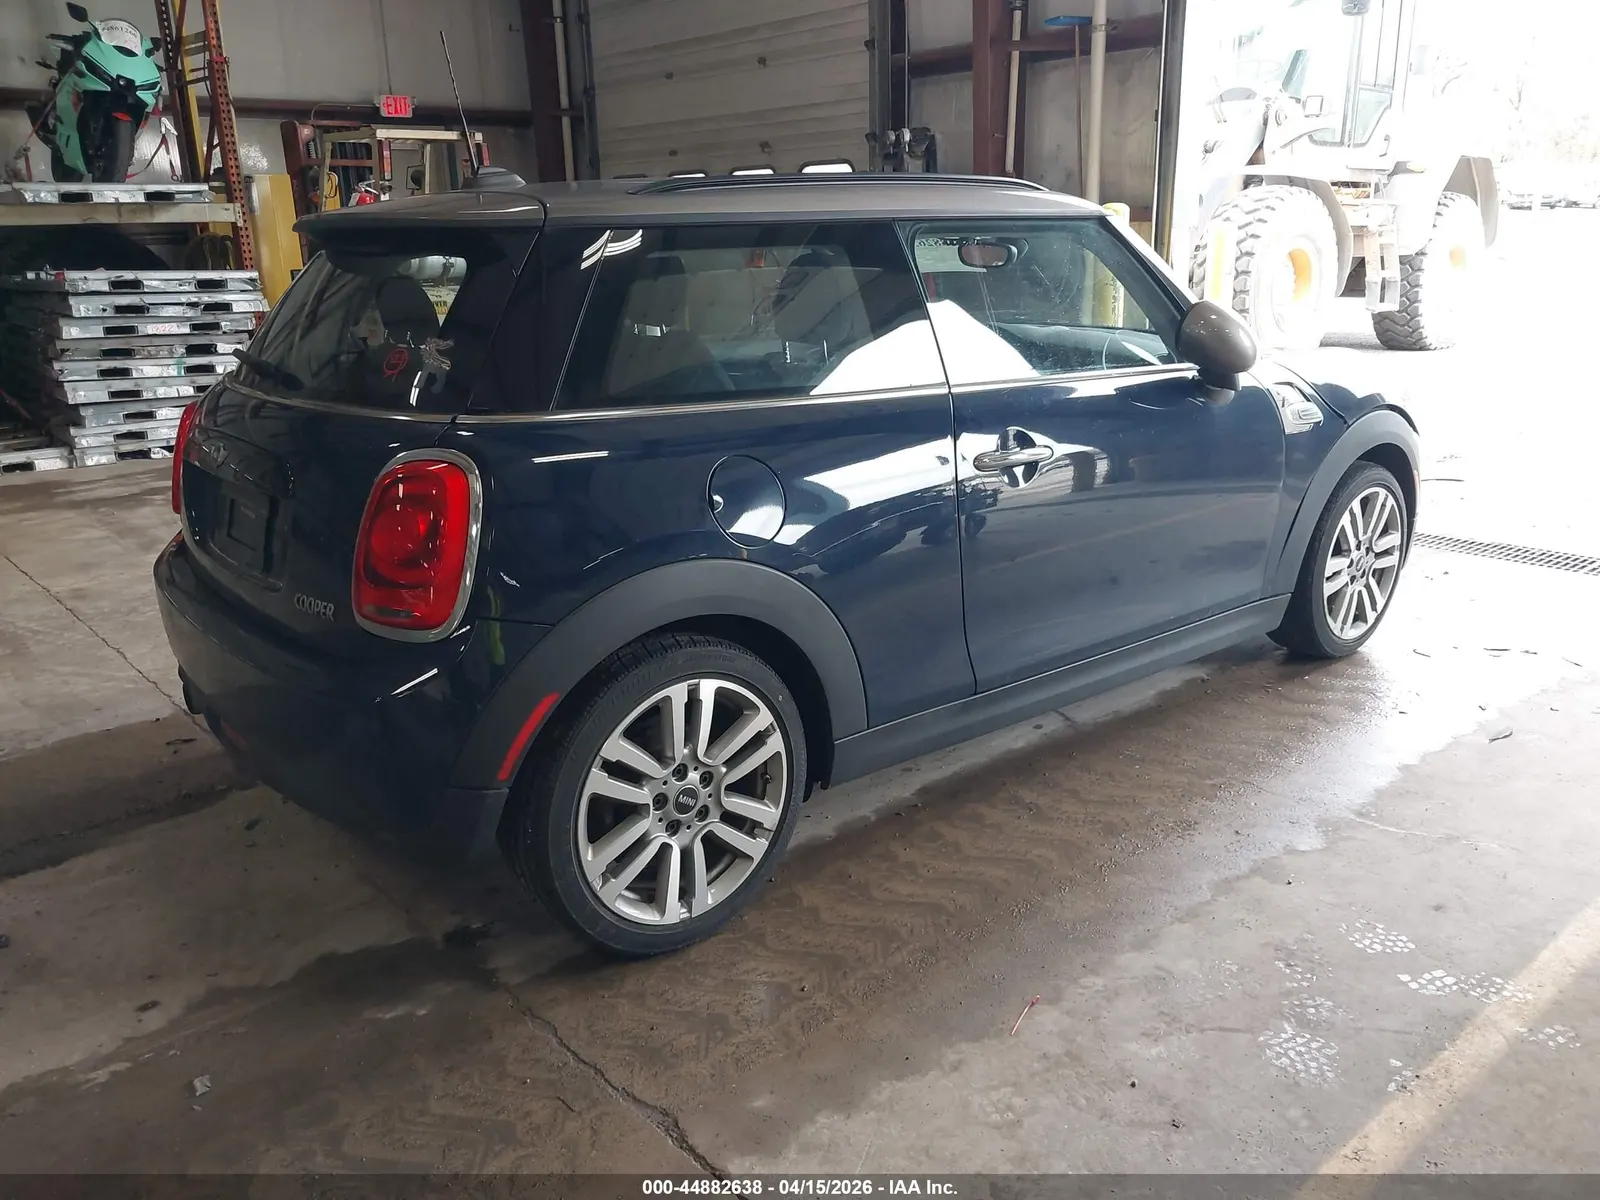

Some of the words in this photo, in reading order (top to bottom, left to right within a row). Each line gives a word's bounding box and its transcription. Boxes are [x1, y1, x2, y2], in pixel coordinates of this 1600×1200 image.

[385, 96, 409, 115] EXIT
[294, 593, 335, 622] COOPER
[677, 794, 697, 807] MINI
